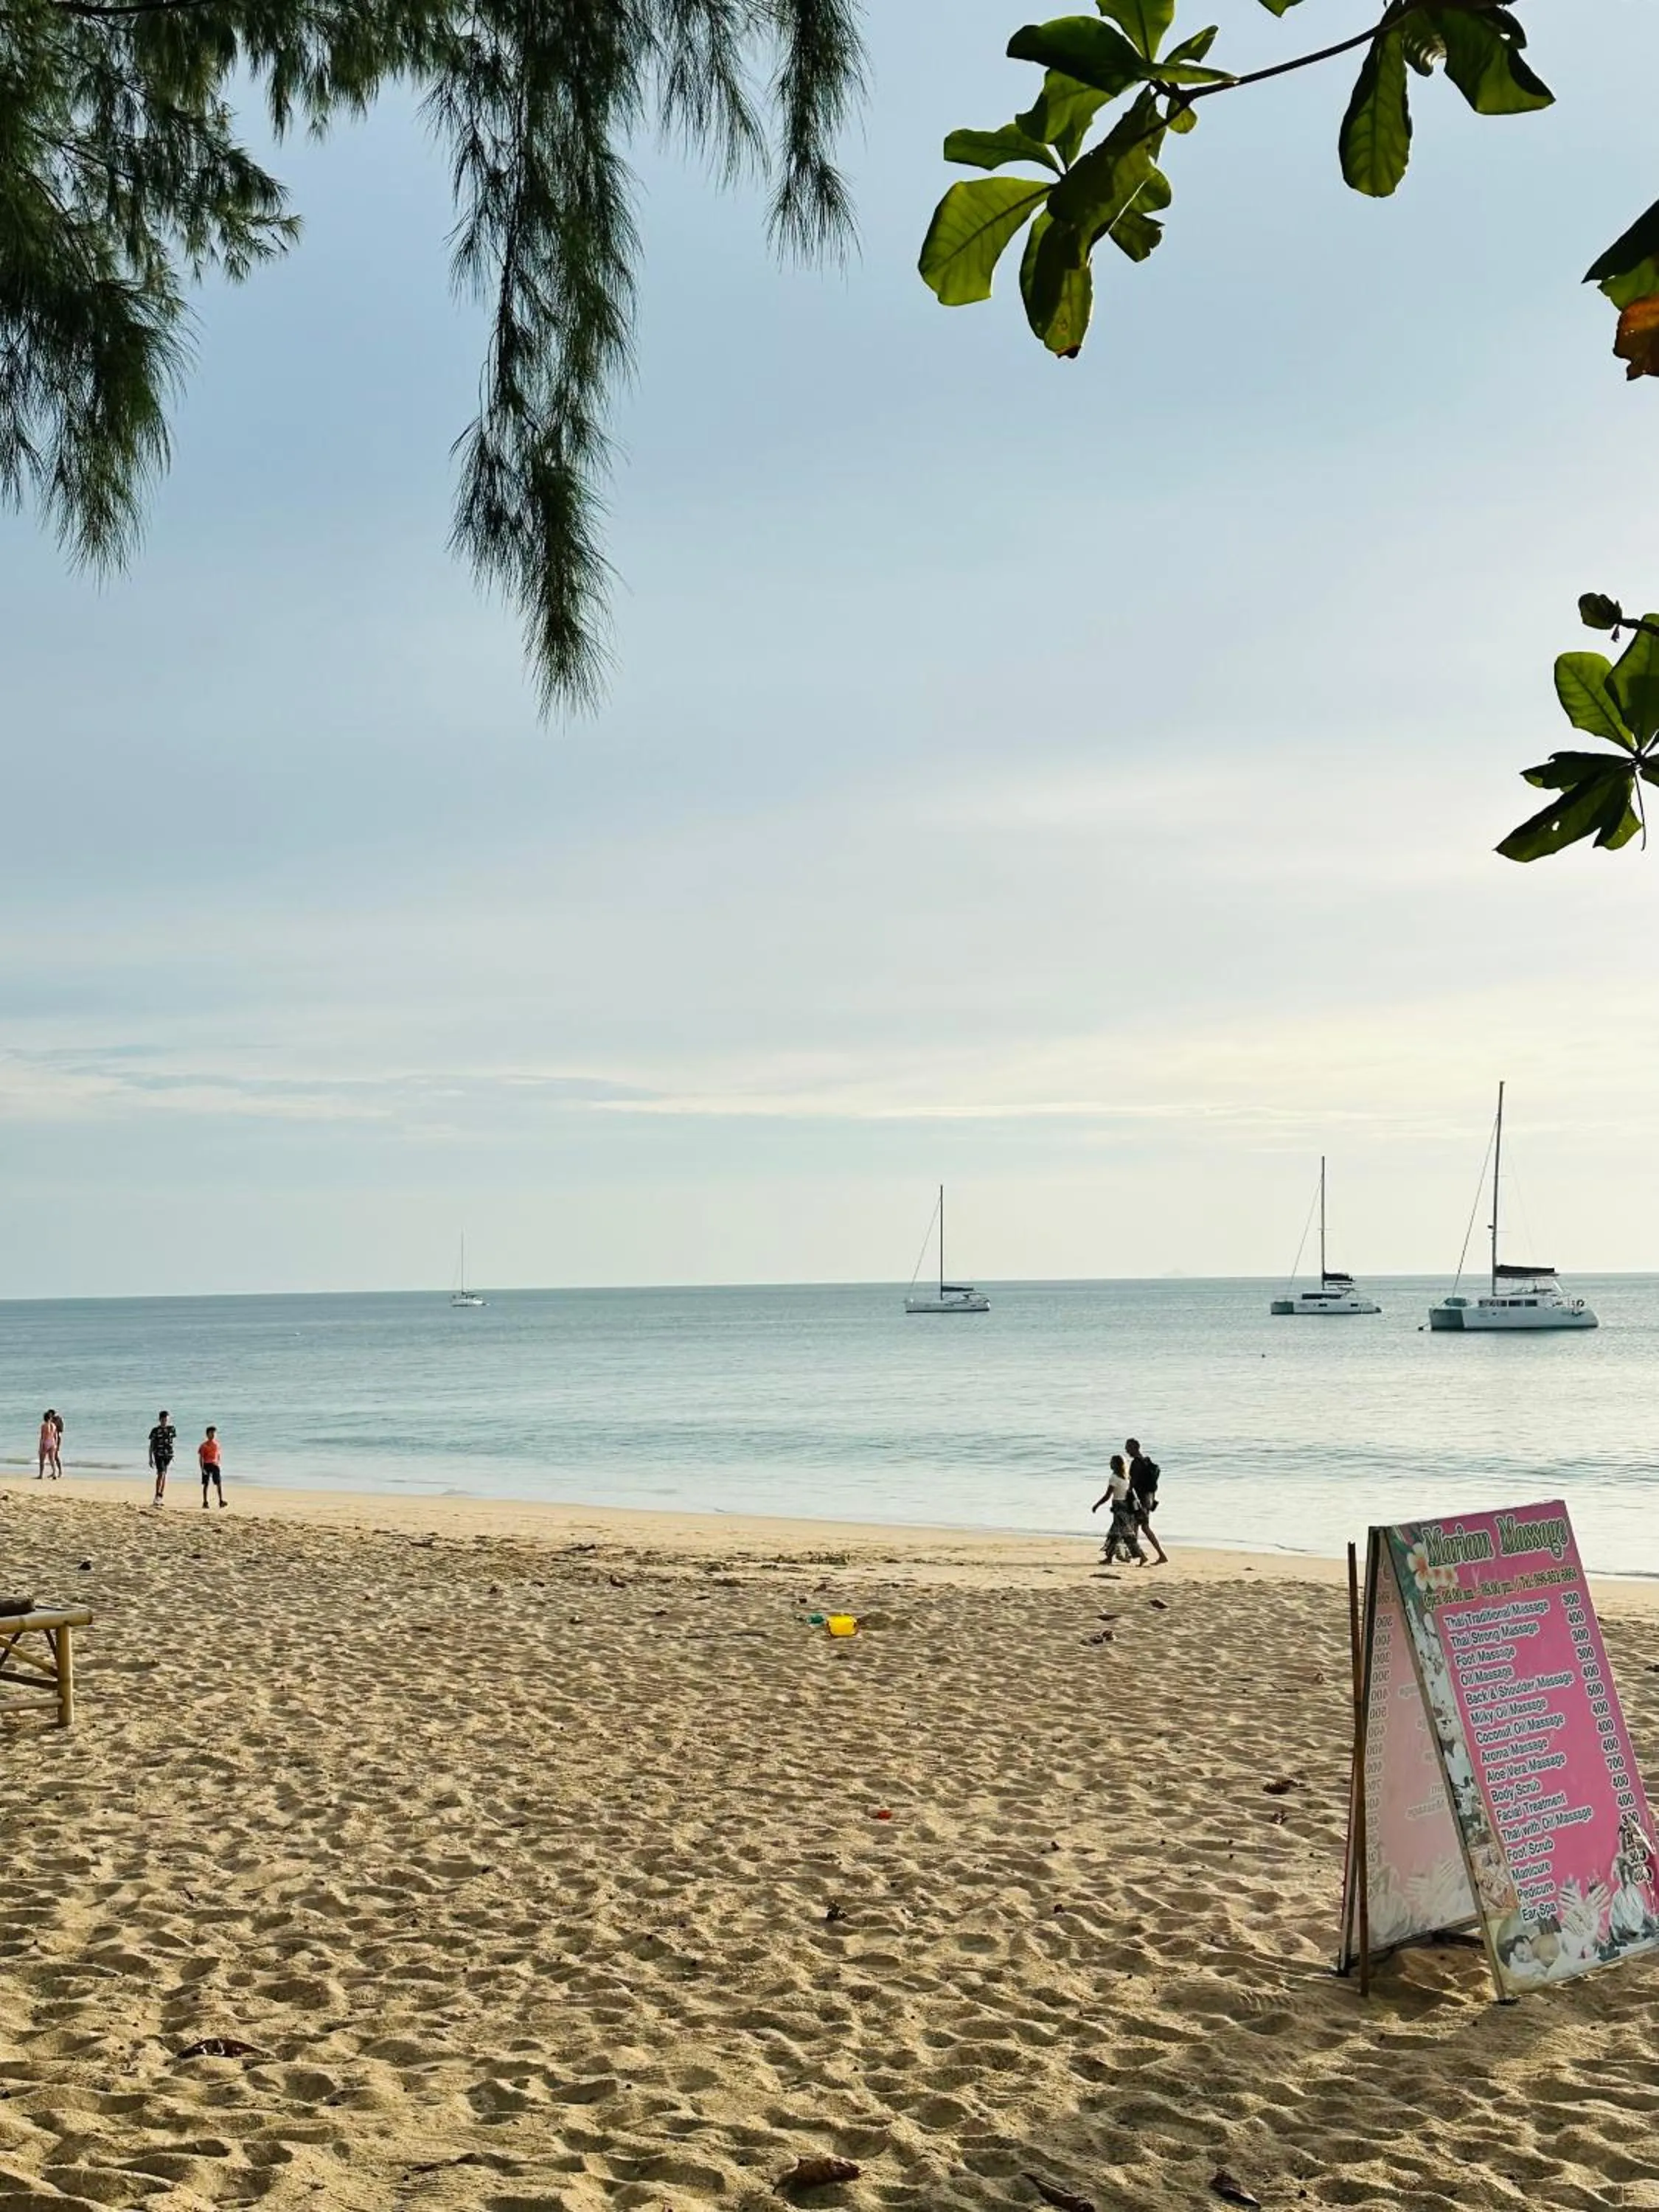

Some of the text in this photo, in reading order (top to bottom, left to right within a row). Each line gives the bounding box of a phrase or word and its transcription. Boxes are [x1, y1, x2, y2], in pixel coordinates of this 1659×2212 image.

[1496, 1515, 1568, 1559] Massage
[1445, 1593, 1579, 1628] Thai Traditional Massage 300
[1451, 1610, 1585, 1647] Thai Strong Massage 400
[1456, 1628, 1589, 1666] Foot Massage 300
[1461, 1672, 1473, 1686] Oil
[1475, 1666, 1513, 1683] Massage
[1466, 1689, 1488, 1705] Back
[1499, 1679, 1536, 1697] Shoulder
[1537, 1674, 1573, 1688] Massage
[1583, 1665, 1599, 1677] 400
[1470, 1683, 1603, 1724] Milky Oil Massage 500
[1476, 1701, 1608, 1744] Coconut Oil Massage 400
[1481, 1719, 1613, 1763] Aroma Massage 400
[1487, 1737, 1618, 1783] Aloe Vera Massage 400
[1491, 1756, 1624, 1802] Body Scrub 700
[1497, 1773, 1629, 1822] Facial Treatment 400
[1502, 1793, 1634, 1841] Thai with Oil Massage 400
[1506, 1846, 1527, 1862] Foot
[1528, 1837, 1554, 1856] Scrub
[1512, 1860, 1551, 1880] Manicure
[1517, 1881, 1555, 1900] Pedicure
[1522, 1906, 1537, 1921] Ear
[1539, 1902, 1556, 1916] Spa
